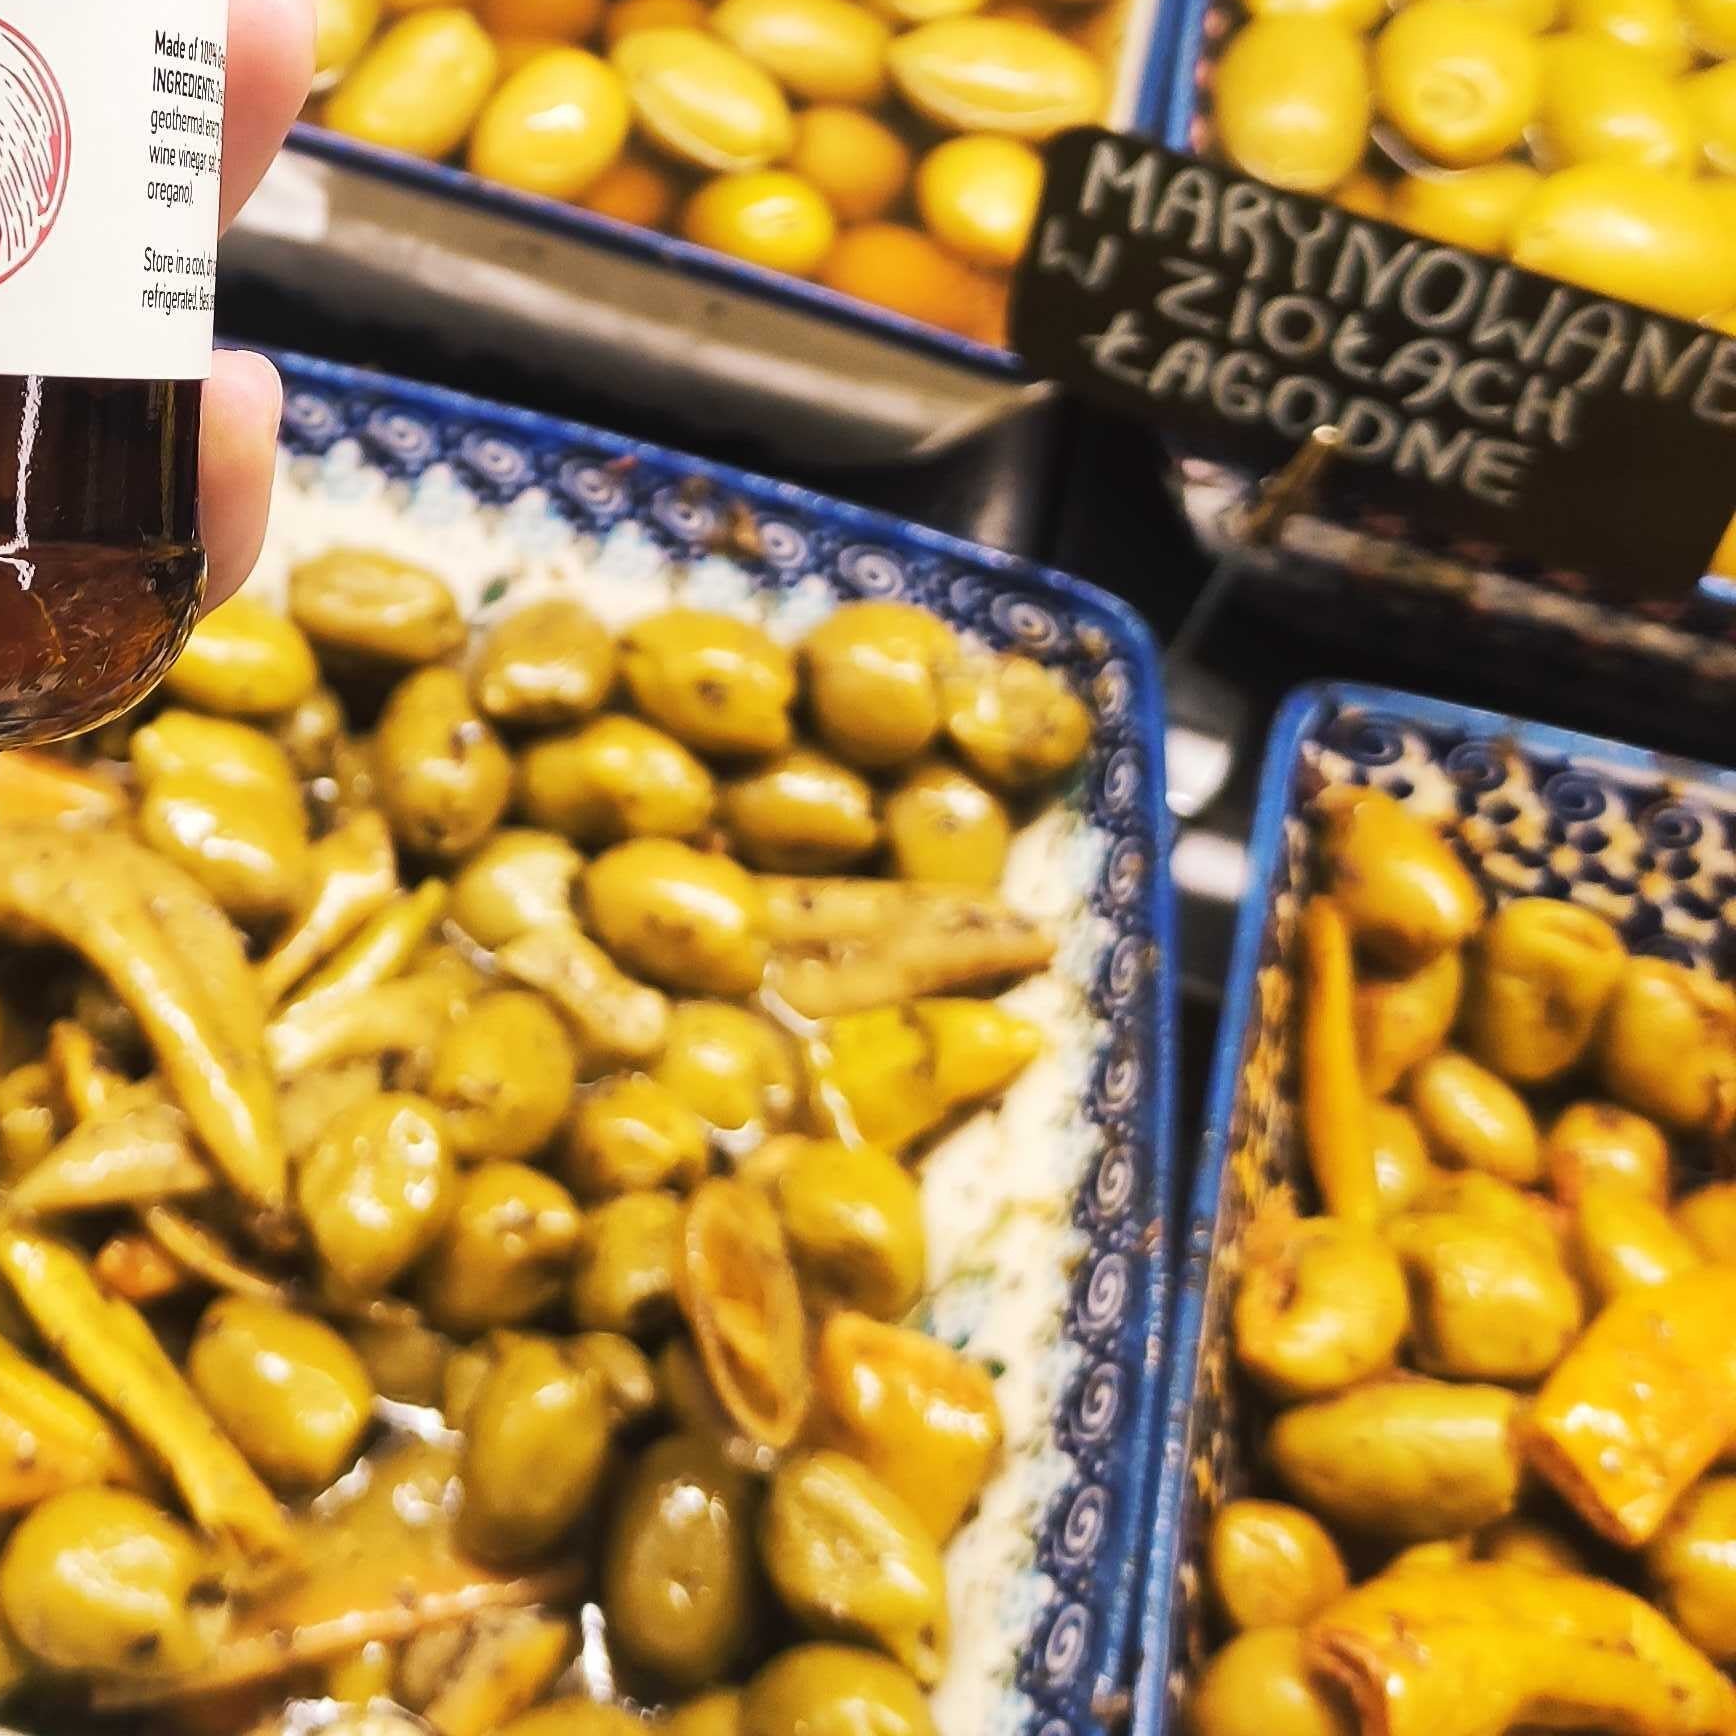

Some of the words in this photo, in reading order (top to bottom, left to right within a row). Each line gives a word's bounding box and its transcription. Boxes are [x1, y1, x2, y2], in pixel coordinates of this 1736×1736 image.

[154, 29, 186, 60] Made
[188, 36, 199, 63] of
[150, 105, 205, 137] geothermal
[149, 138, 176, 166] wine
[144, 246, 174, 273] Store
[175, 248, 184, 274] in
[1077, 139, 1736, 426] MARYNOWANE
[1038, 215, 1121, 291] W
[1154, 255, 1577, 446] ZIOŁACH
[1077, 308, 1533, 507] ŁAGODNE
